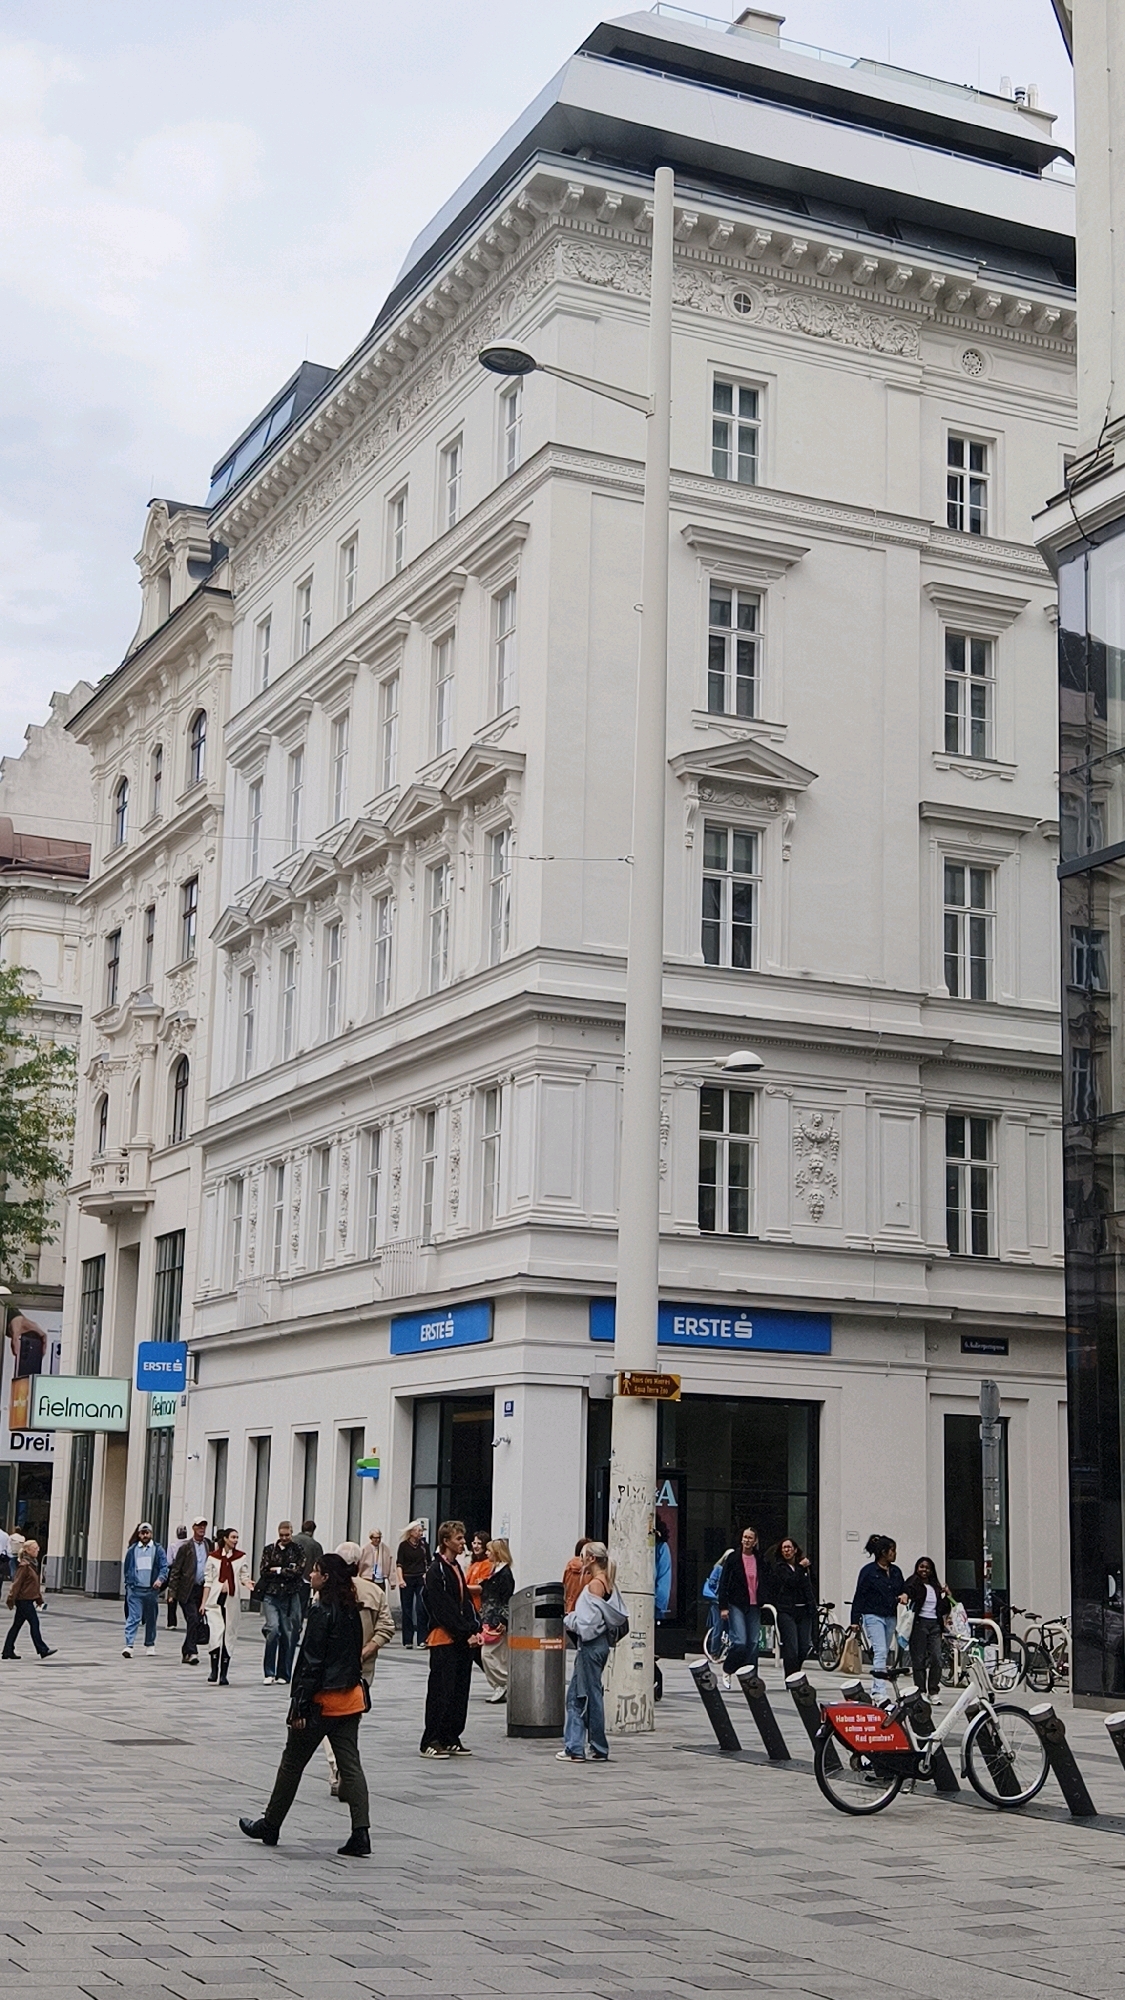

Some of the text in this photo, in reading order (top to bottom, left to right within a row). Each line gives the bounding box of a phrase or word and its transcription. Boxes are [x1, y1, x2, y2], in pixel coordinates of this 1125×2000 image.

[420, 1321, 445, 1342] ERSTE
[673, 1316, 732, 1338] ERSTE
[143, 1361, 172, 1372] ERSTE
[39, 1395, 123, 1419] fielmann
[10, 1432, 54, 1452] Drei.
[836, 1714, 881, 1723] Haben Sie Wien
[855, 1734, 867, 1742] Rad
